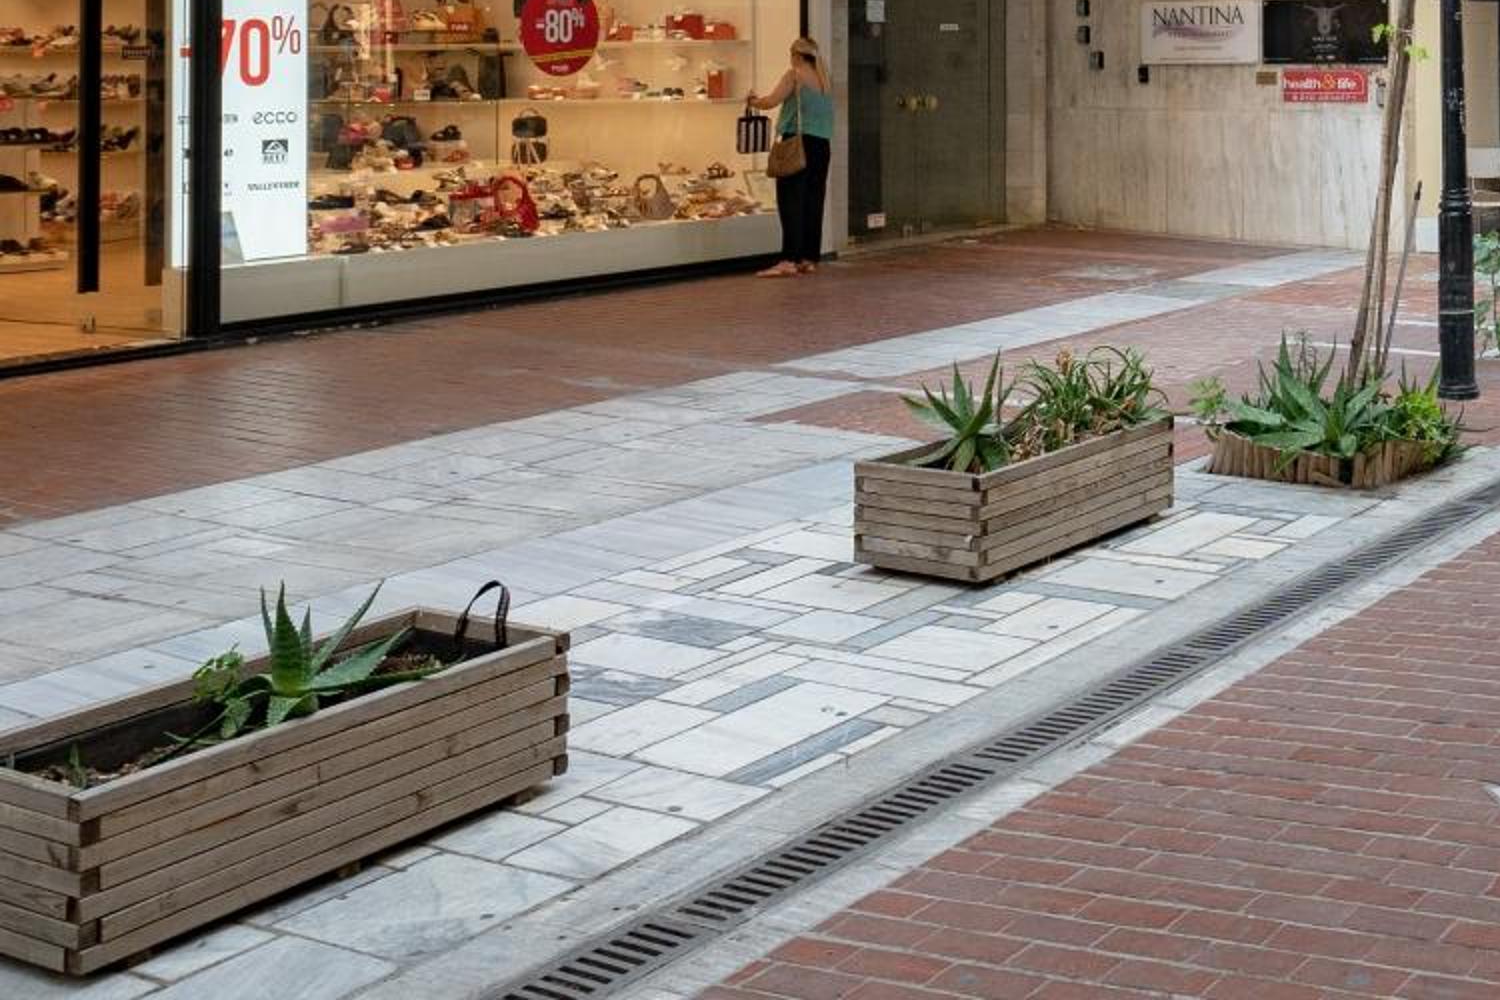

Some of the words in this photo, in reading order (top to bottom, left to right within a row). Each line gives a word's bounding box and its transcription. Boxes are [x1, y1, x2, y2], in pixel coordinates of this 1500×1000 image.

[1152, 5, 1245, 25] NANTINA
[535, 8, 585, 44] -80%
[253, 111, 298, 125] ecco
